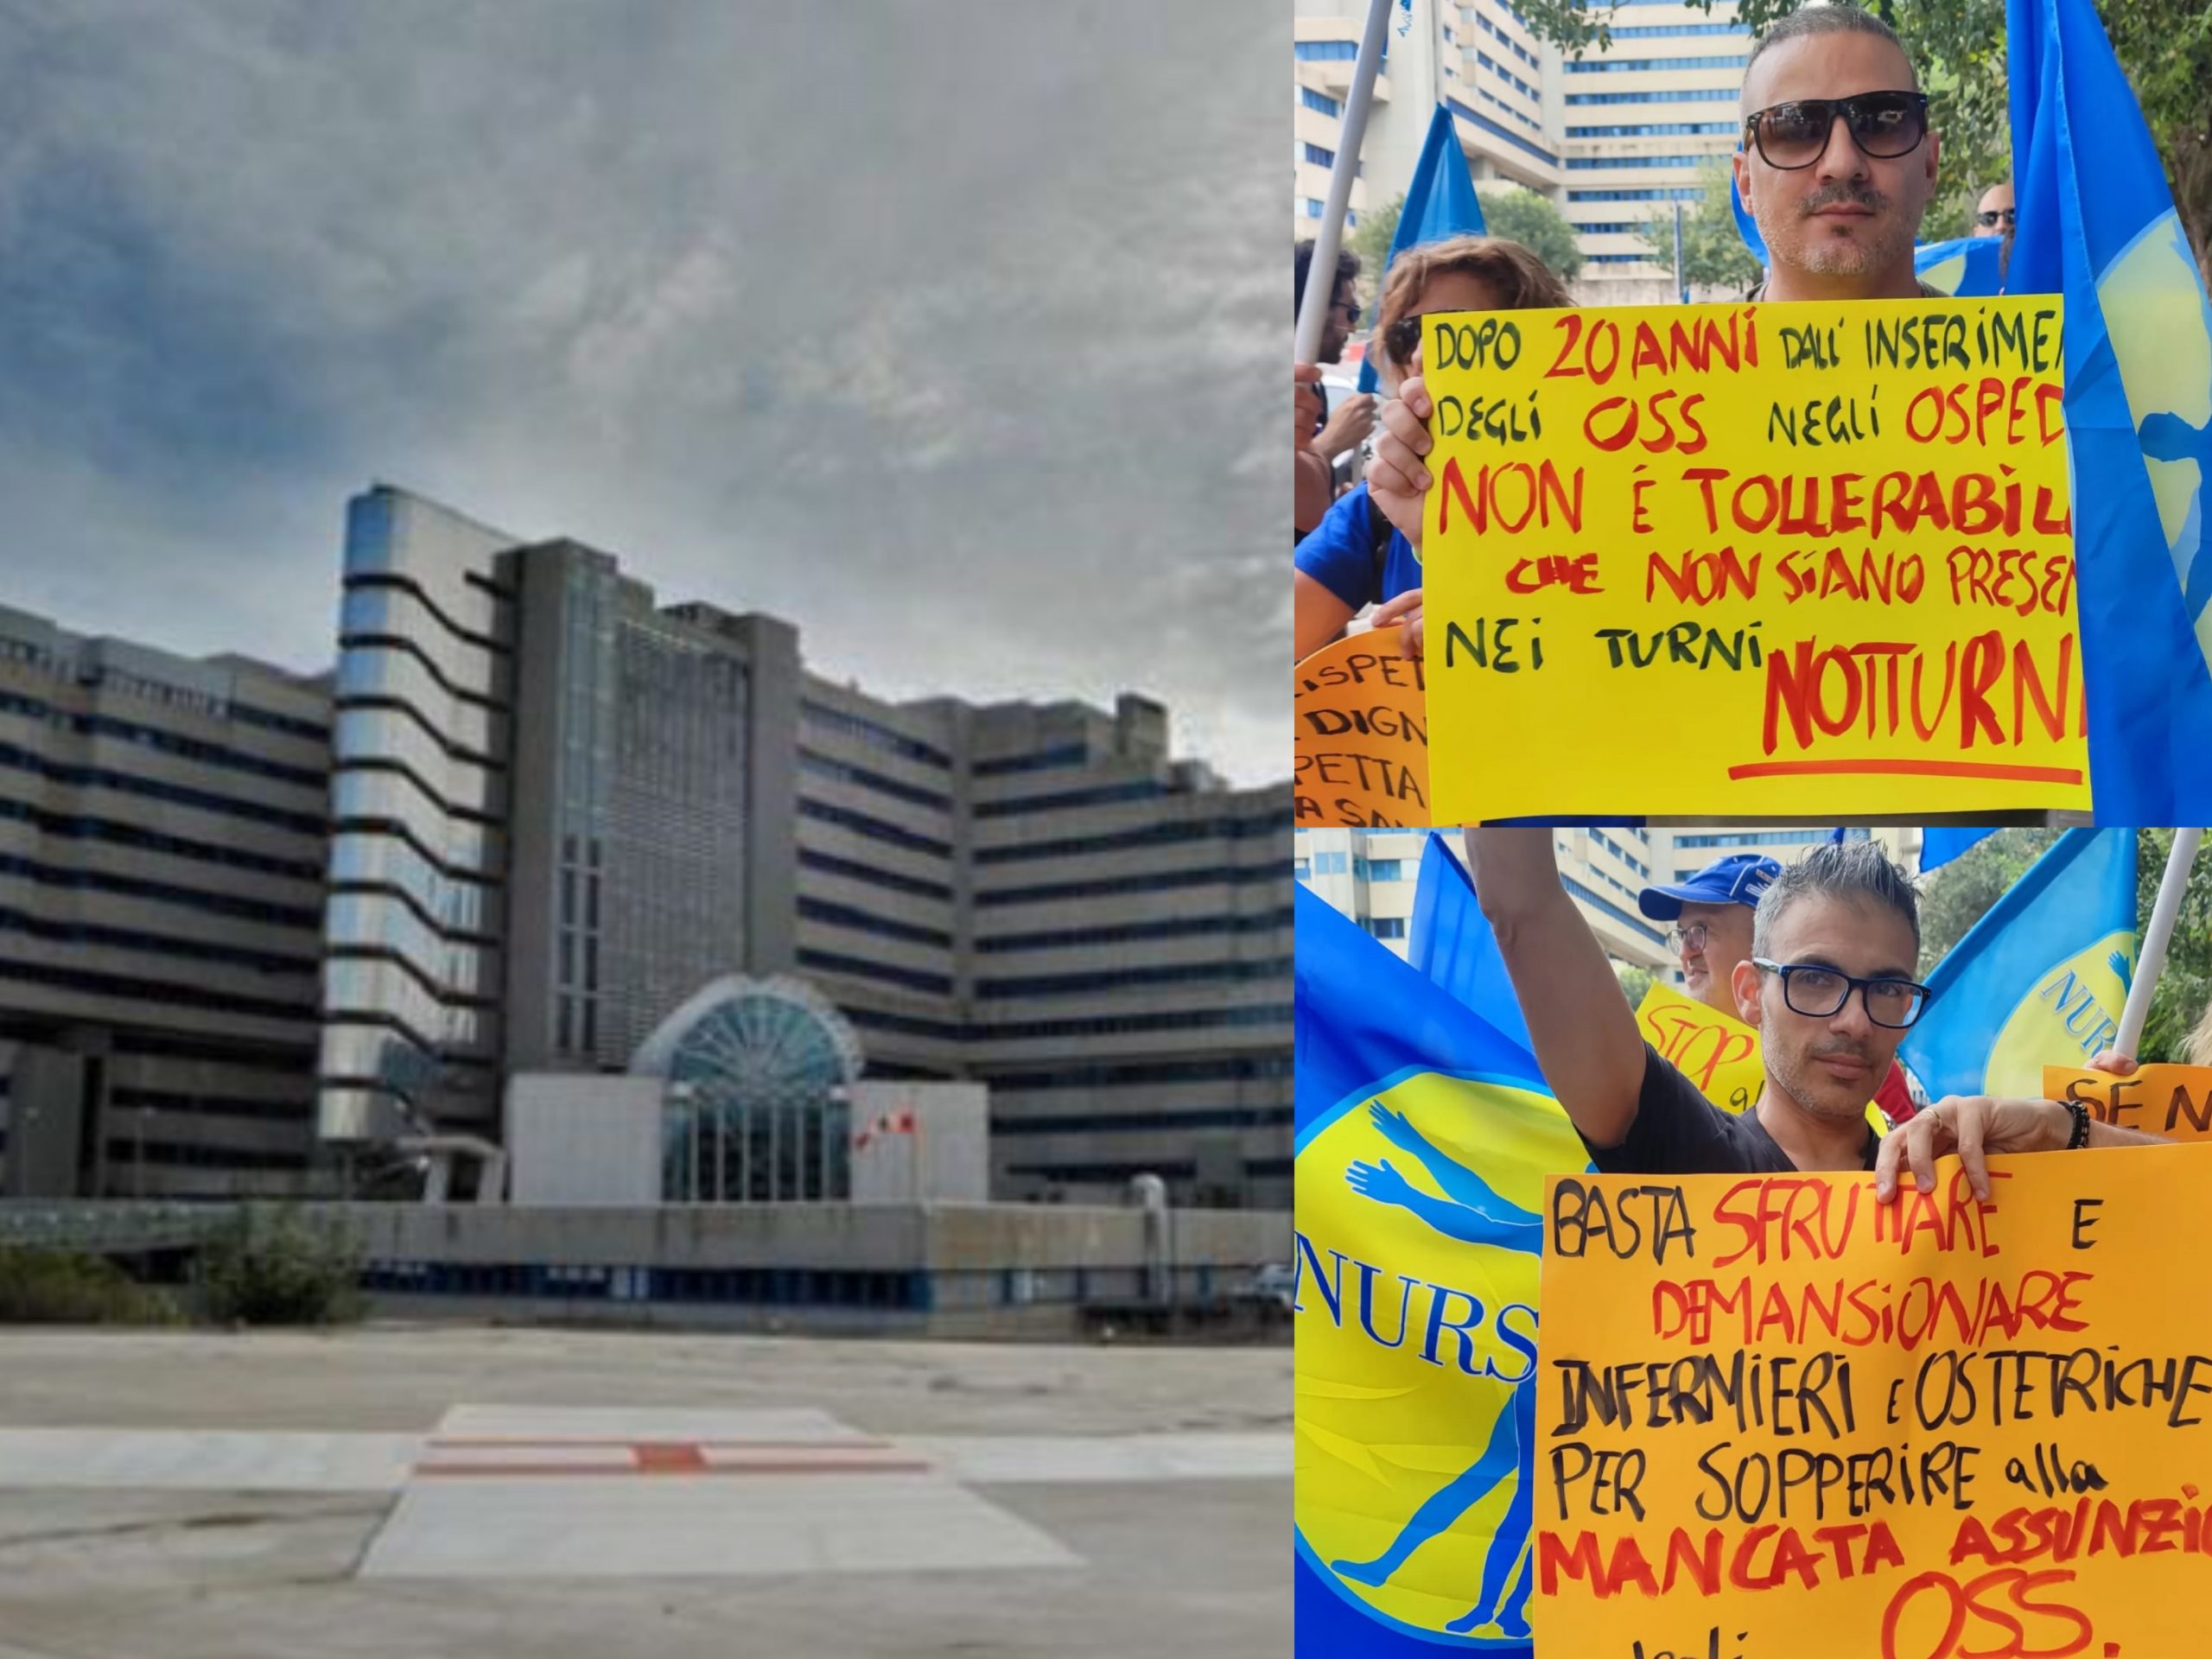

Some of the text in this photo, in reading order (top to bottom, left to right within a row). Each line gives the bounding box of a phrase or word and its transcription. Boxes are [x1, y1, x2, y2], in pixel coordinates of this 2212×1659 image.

[1434, 318, 1521, 370] DOPO
[1583, 390, 1707, 454] OSS
[1439, 456, 1584, 536] NON
[1505, 552, 1605, 594] CHE
[1646, 547, 1762, 606] NON
[1648, 1005, 1754, 1092] STOP
[1553, 1179, 1696, 1266] BASTA
[2072, 1198, 2104, 1249] E
[1294, 1230, 1539, 1383] NURS
[1548, 1441, 1646, 1522] PER
[2005, 1442, 2109, 1498] alla
[1539, 1517, 1905, 1599] MANCATA
